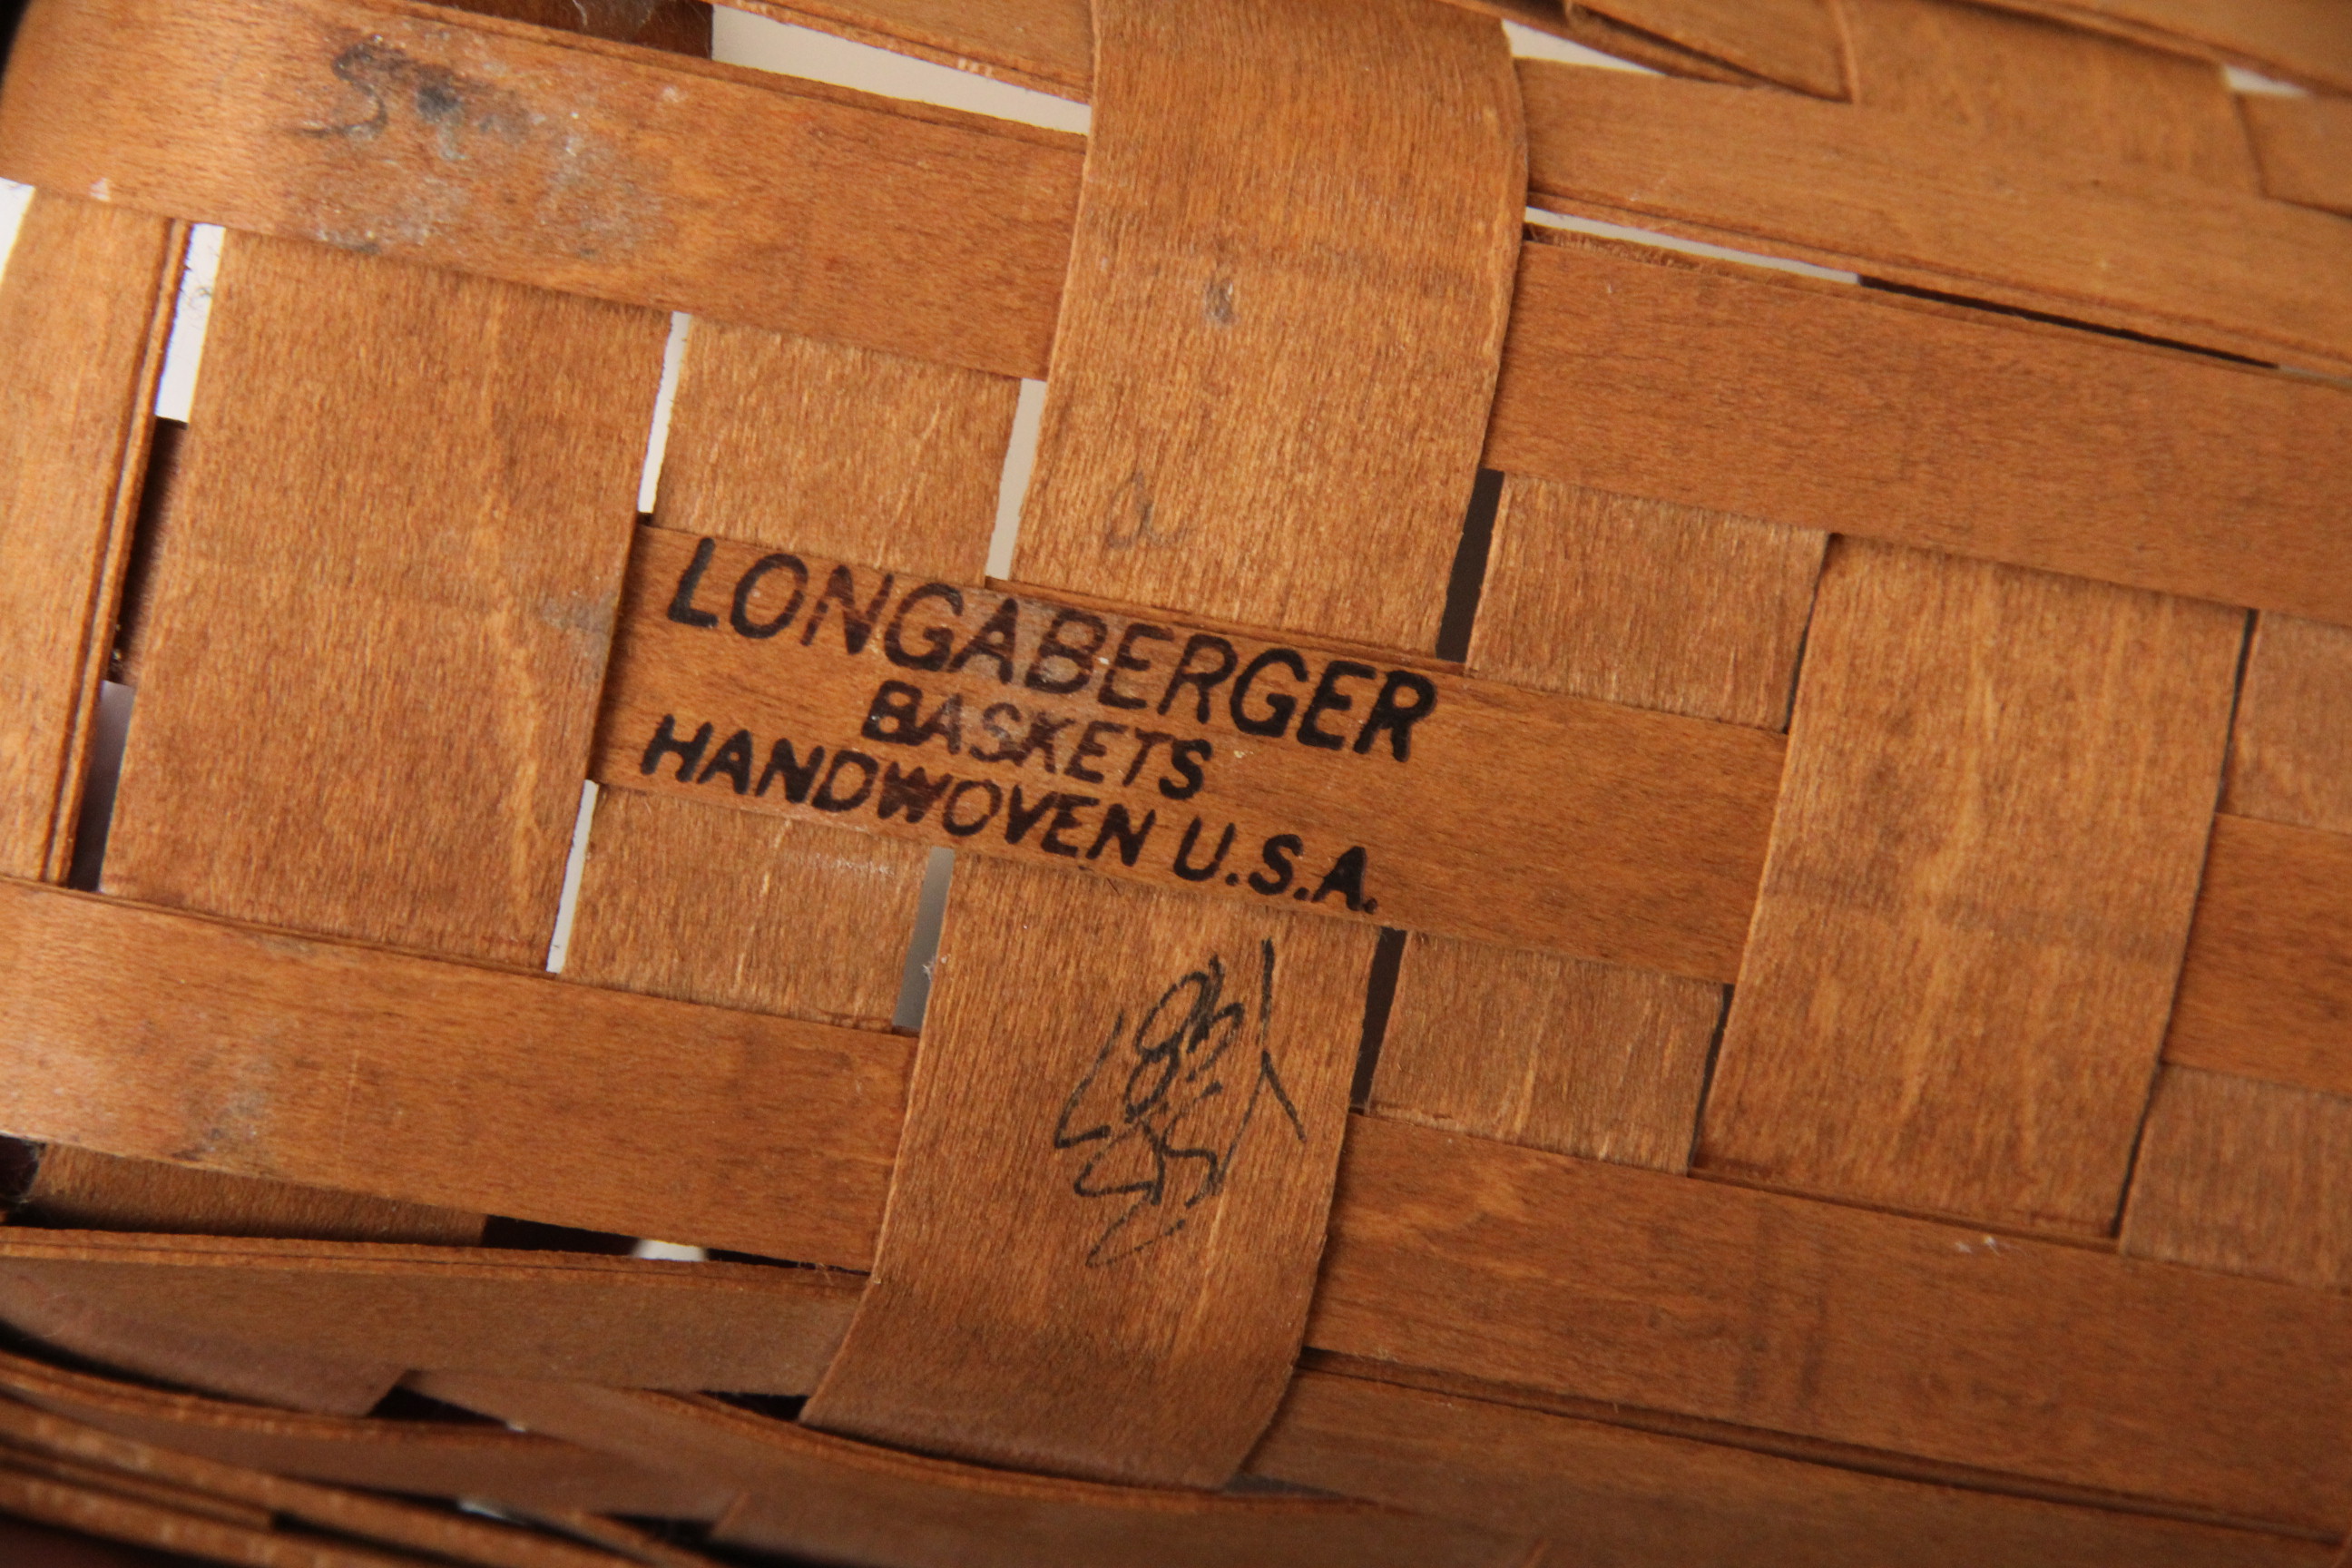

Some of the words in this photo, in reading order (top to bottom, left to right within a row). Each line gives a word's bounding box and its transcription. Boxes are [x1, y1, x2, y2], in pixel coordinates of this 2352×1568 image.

[667, 537, 1436, 761] LONGABERGER
[862, 680, 1212, 799] BASKETS
[640, 713, 1157, 867] HANDWOVEN
[1173, 817, 1377, 914] U.S.A.
